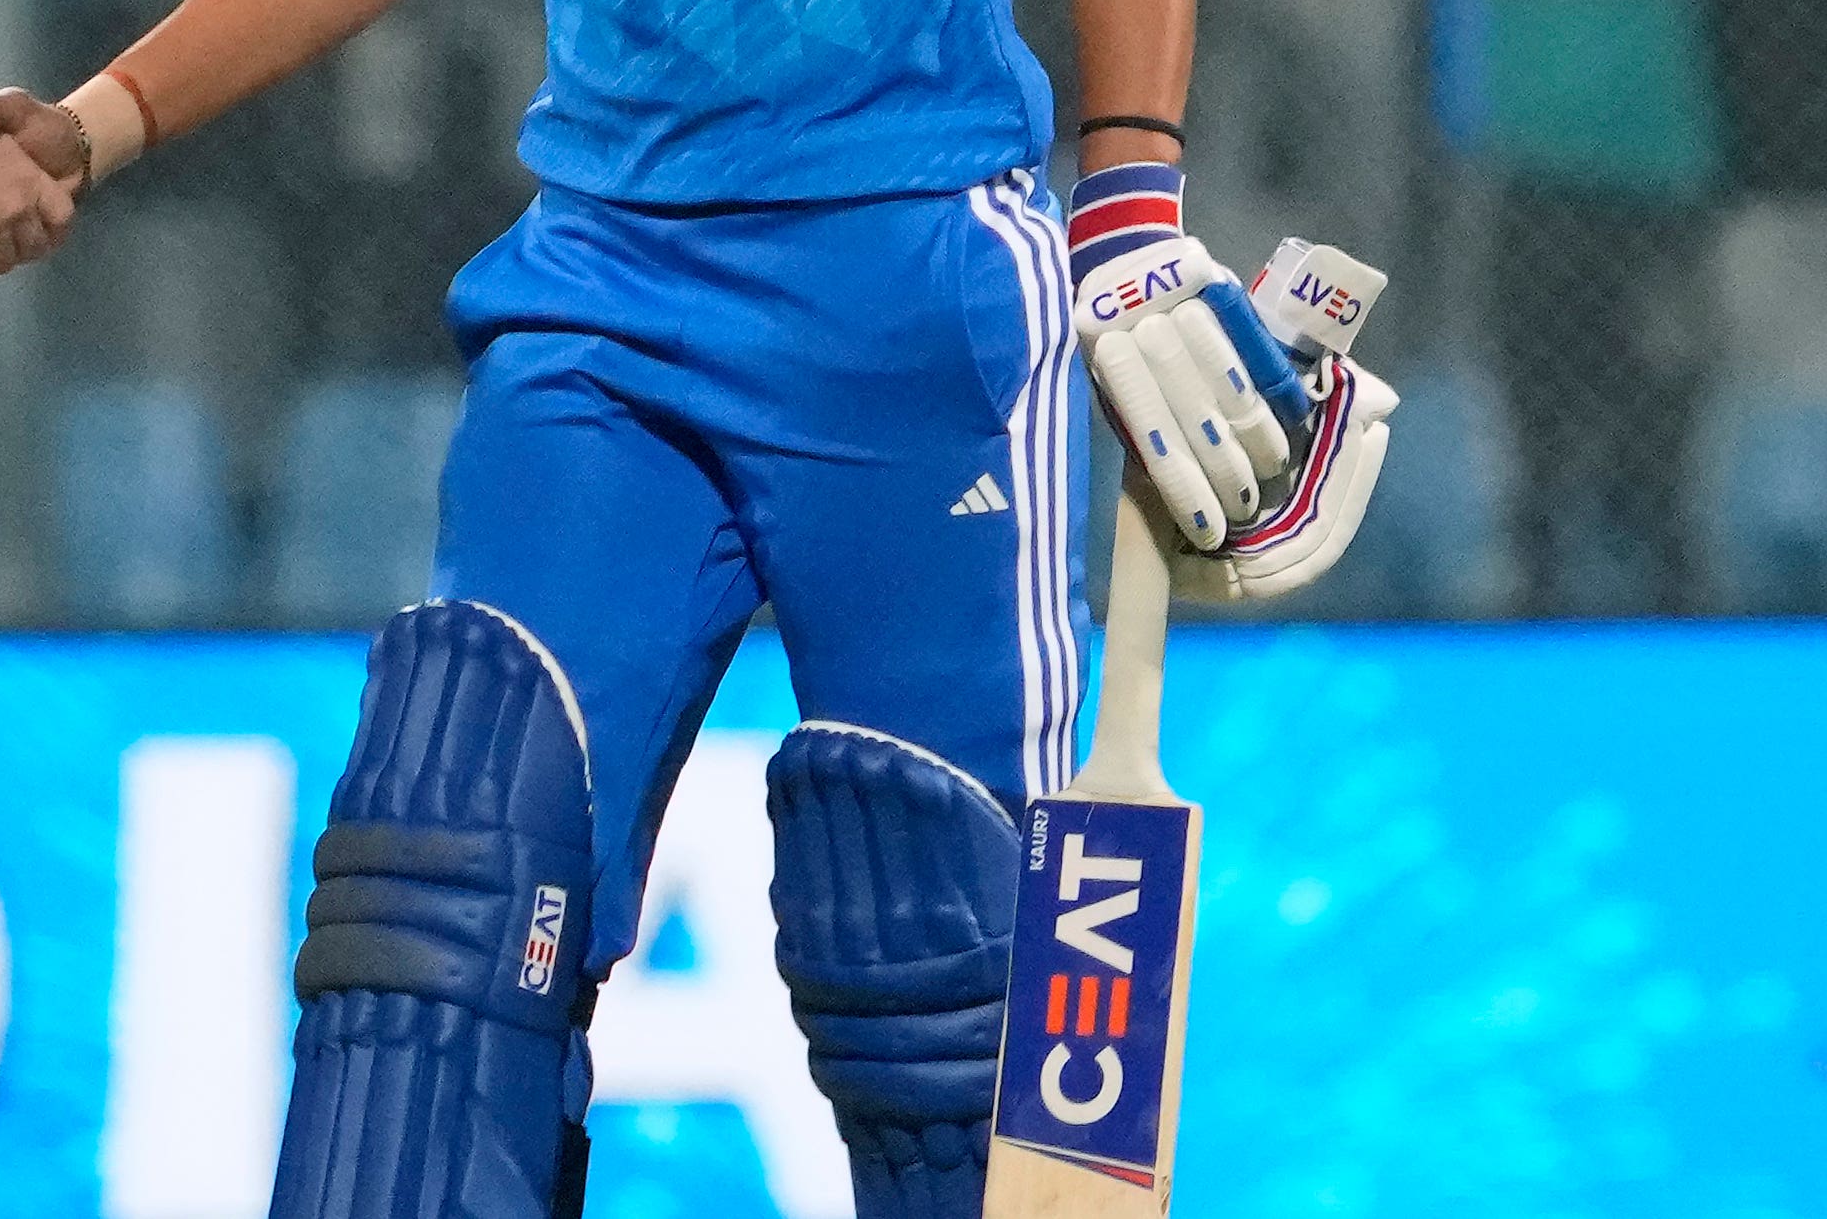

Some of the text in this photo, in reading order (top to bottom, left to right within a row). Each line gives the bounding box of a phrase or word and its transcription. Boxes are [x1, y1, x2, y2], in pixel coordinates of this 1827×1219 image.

[1091, 258, 1184, 322] CEAT
[1290, 272, 1362, 326] CEAT
[1029, 808, 1049, 871] KAUR7
[523, 889, 562, 992] CEAT
[1039, 833, 1143, 1126] CEAT
